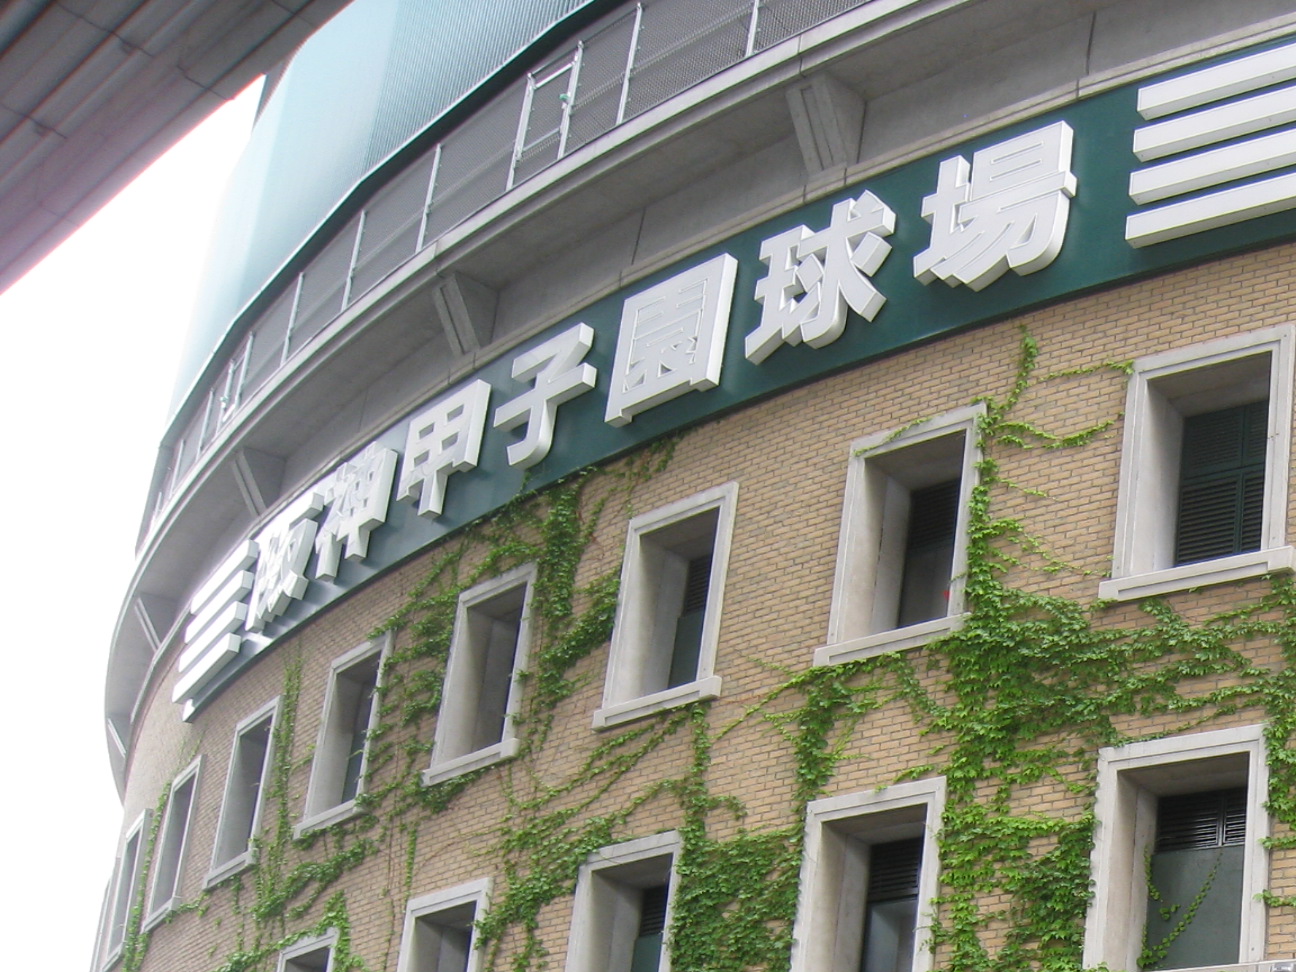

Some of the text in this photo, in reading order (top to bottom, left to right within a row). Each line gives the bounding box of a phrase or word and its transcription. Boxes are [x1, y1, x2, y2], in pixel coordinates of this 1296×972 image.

[245, 120, 1077, 632] 阪神甲子園球場
